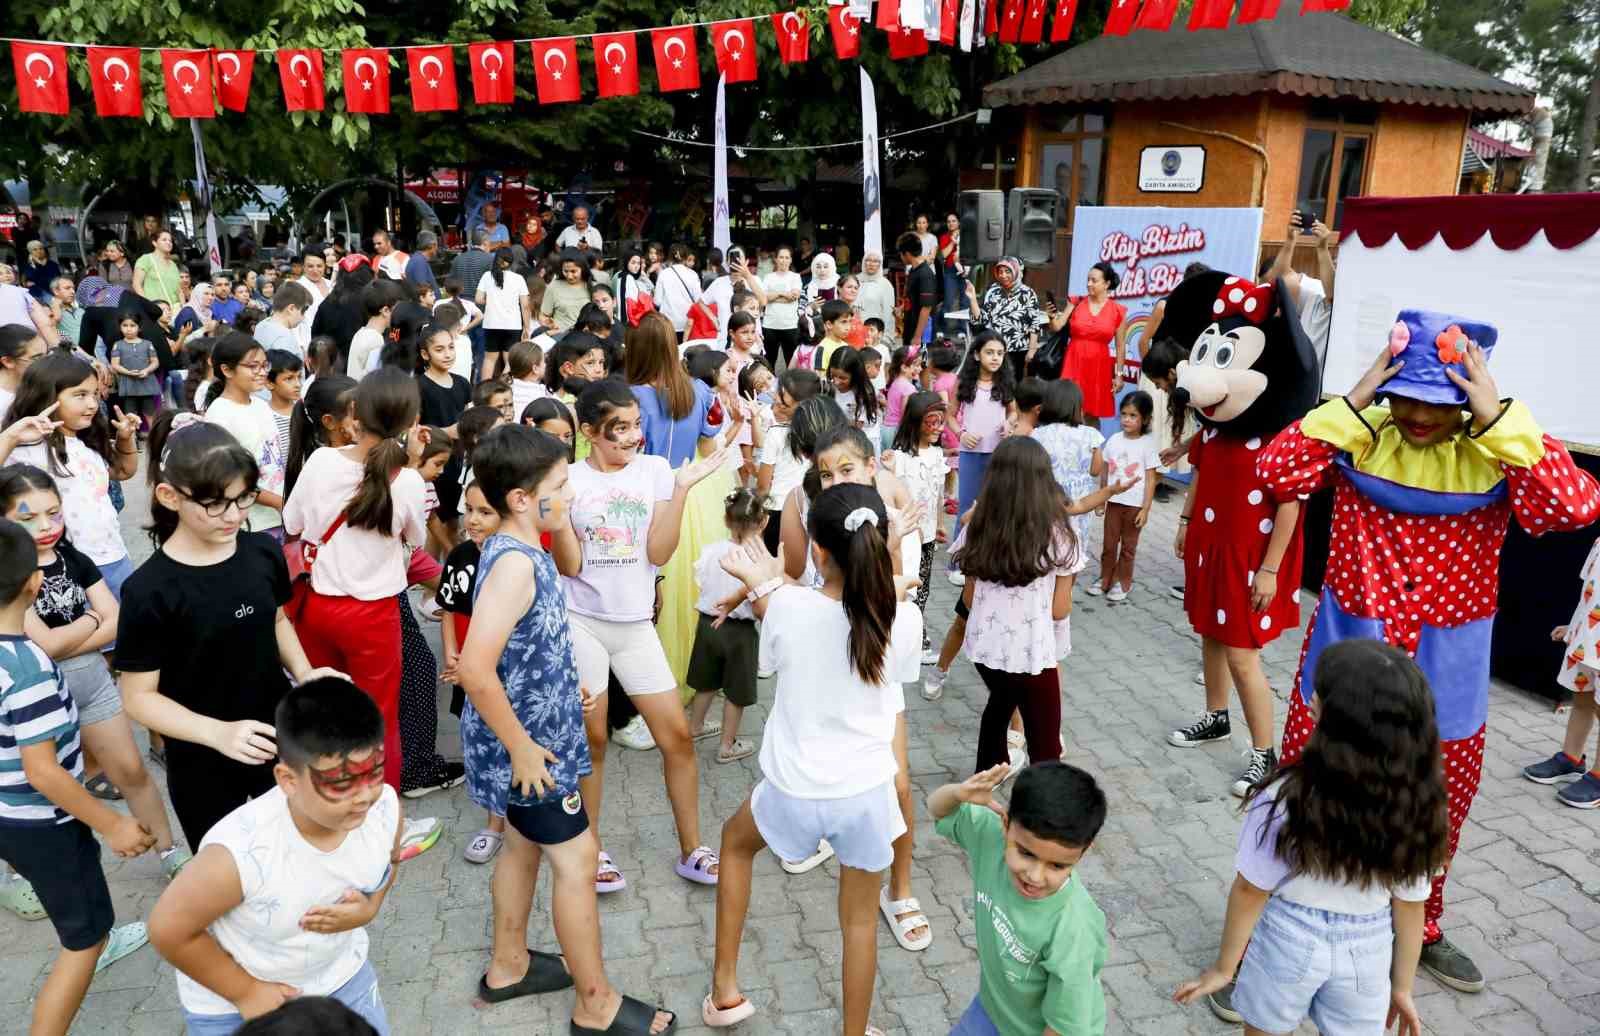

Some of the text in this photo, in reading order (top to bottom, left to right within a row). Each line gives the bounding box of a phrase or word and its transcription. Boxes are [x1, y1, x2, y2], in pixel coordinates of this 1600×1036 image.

[1101, 223, 1204, 268] Köy Bizim
[234, 603, 254, 618] alo
